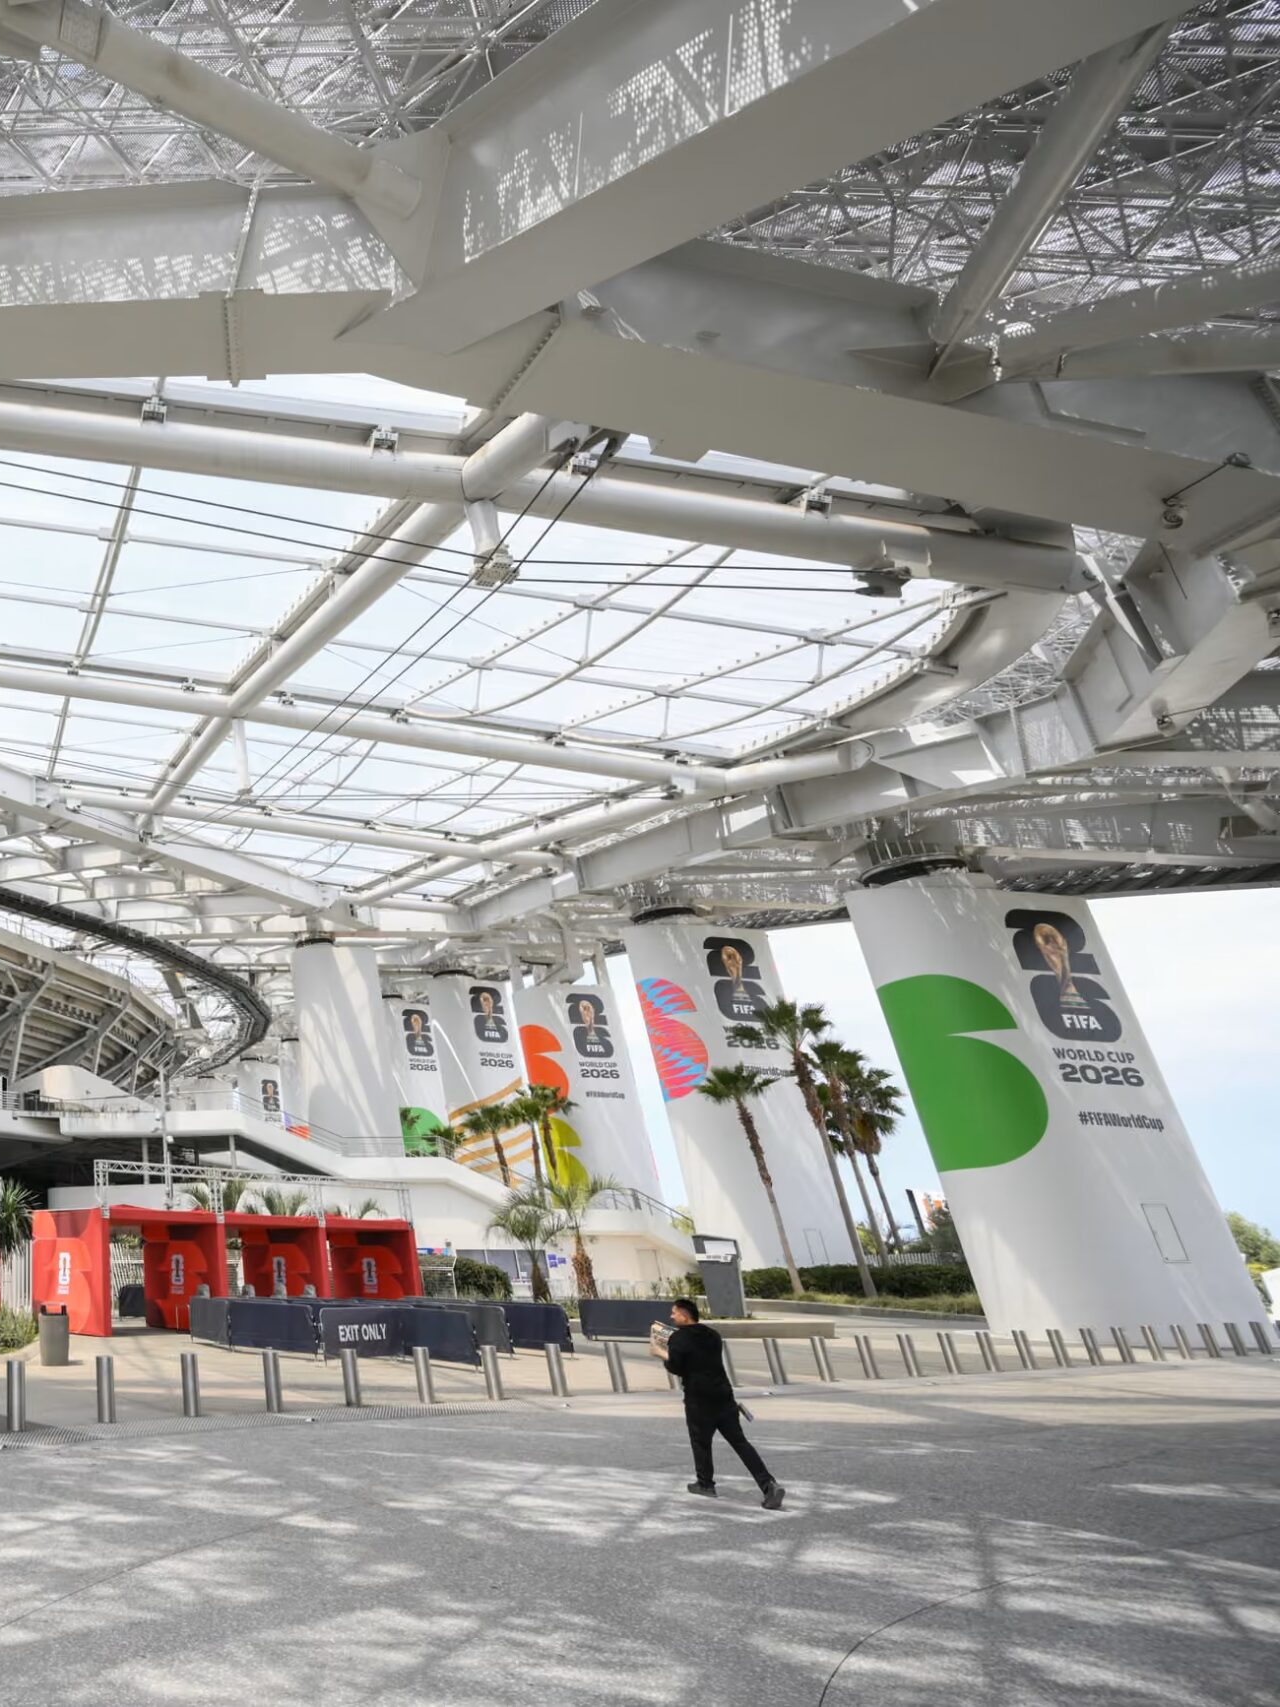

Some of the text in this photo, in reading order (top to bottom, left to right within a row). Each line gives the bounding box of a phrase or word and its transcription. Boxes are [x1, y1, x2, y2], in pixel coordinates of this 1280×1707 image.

[1061, 1013, 1102, 1031] FIFA
[485, 1030, 501, 1038] FIFA
[586, 1044, 605, 1053] FIFA
[1052, 1047, 1135, 1064] WORLD CUP
[480, 1057, 514, 1069] 2026
[580, 1068, 620, 1079] 2026
[1059, 1062, 1145, 1087] 2026
[1077, 1111, 1165, 1134] #FIFAWorldCup
[338, 1323, 387, 1342] EXIT ONLY
